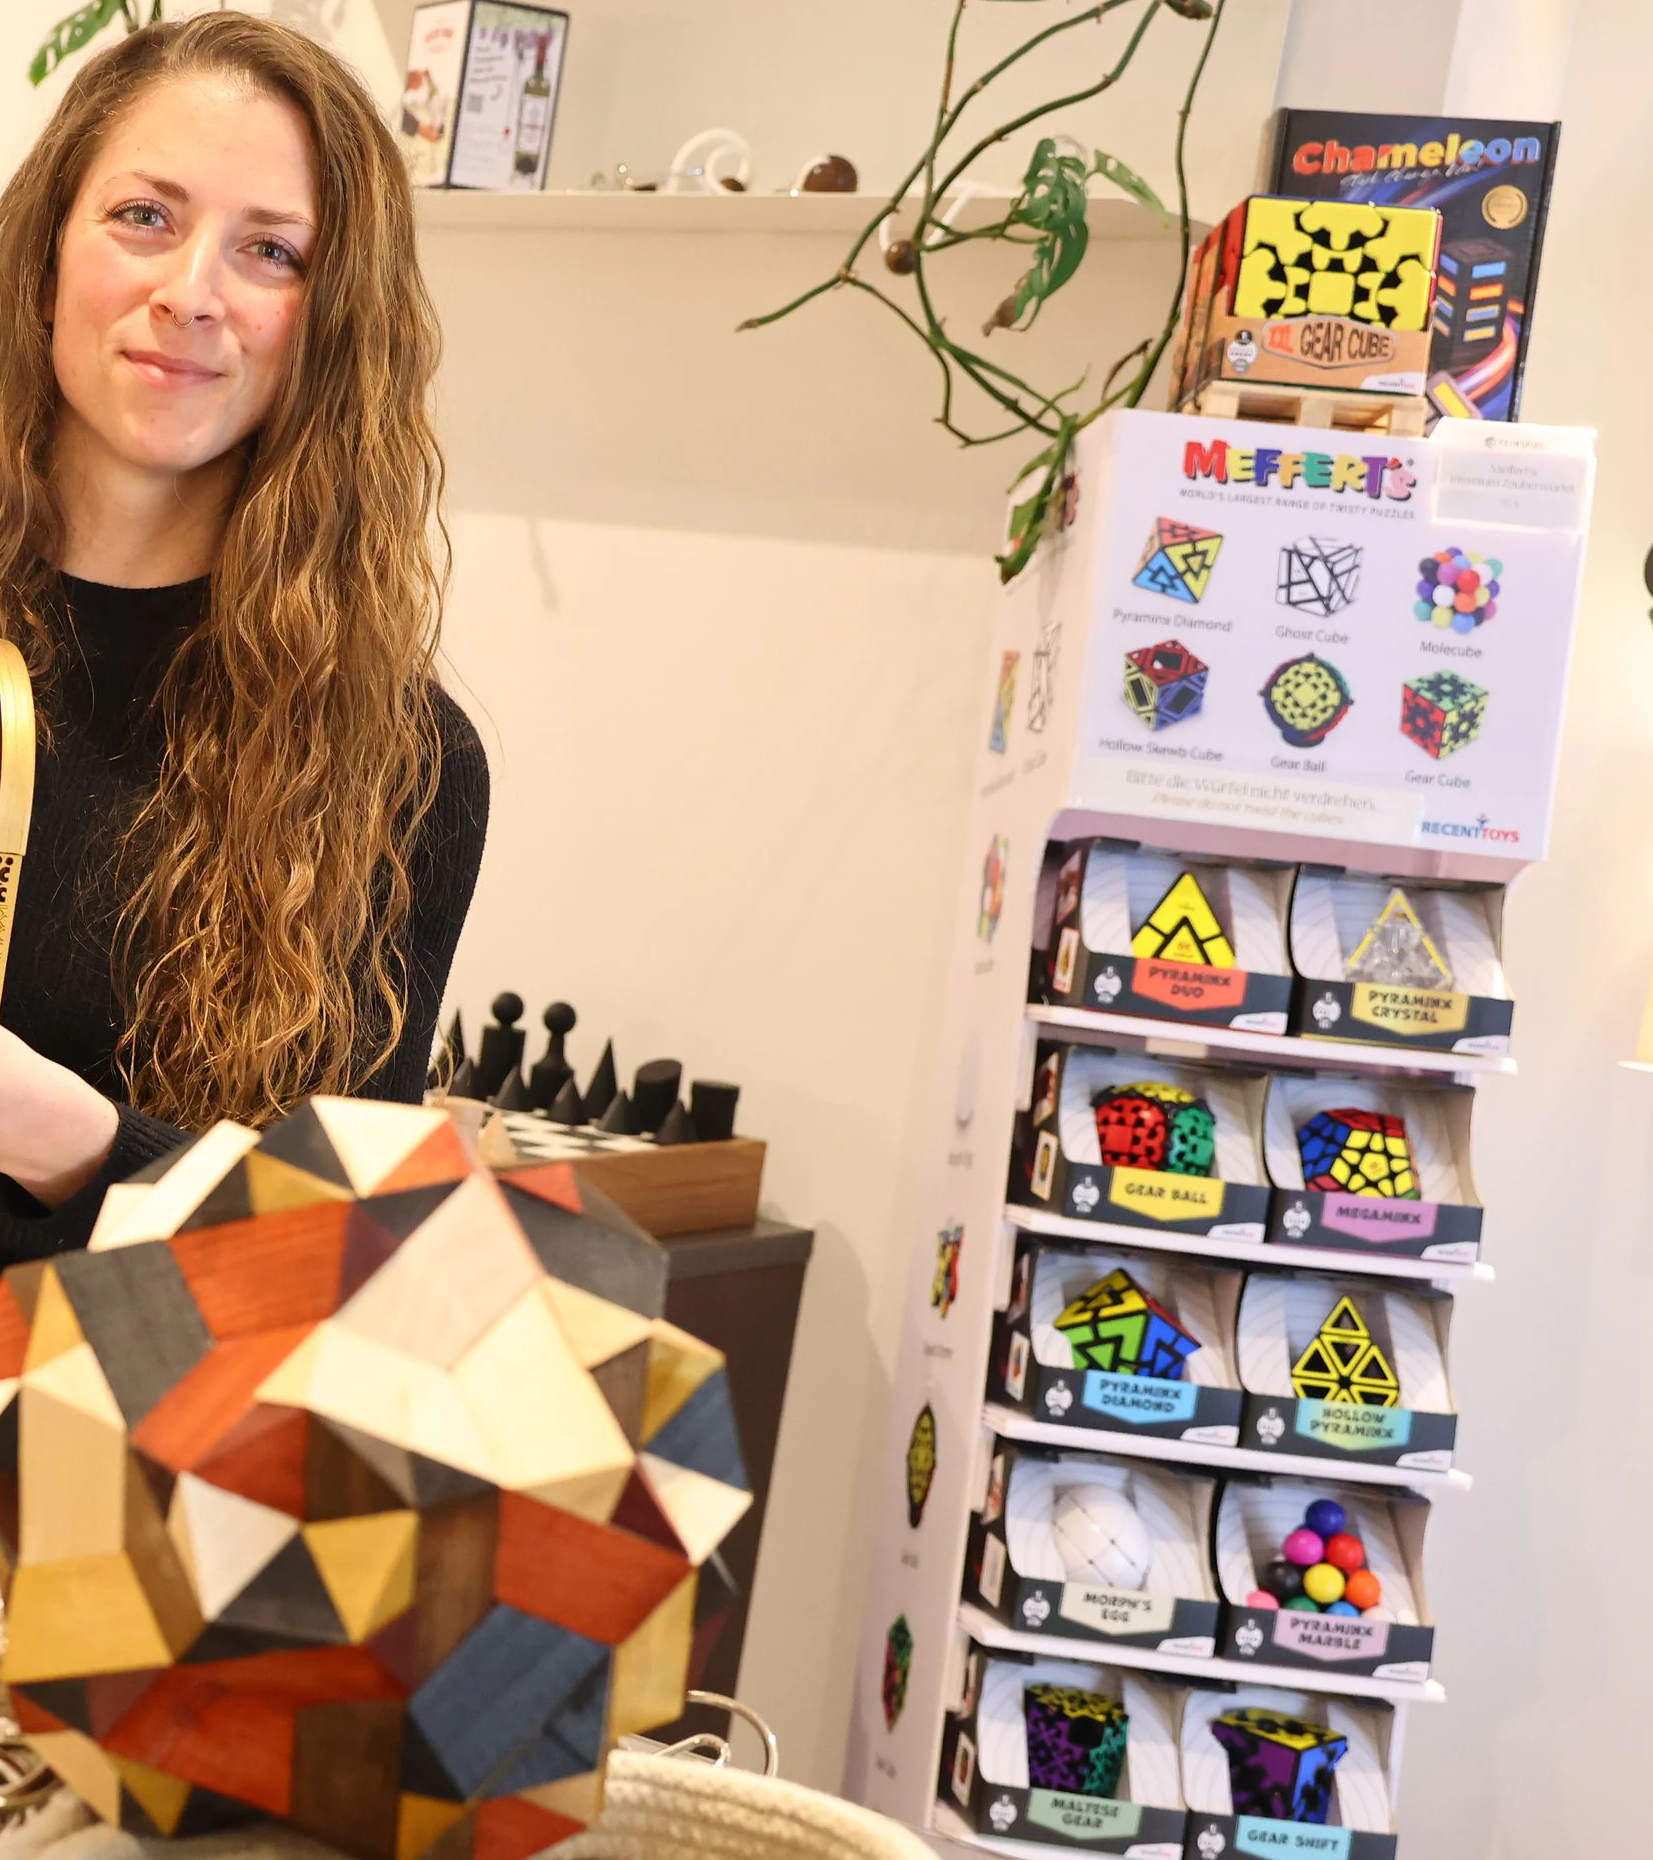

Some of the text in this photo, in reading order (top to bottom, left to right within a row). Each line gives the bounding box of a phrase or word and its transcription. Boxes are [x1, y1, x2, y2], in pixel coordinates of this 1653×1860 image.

[1292, 133, 1540, 175] Chameleon
[1268, 322, 1390, 362] XXL GEAR CUBE
[1183, 439, 1417, 500] MEFFERT'S
[1179, 488, 1415, 520] WORLD'S LARGEST RANGE OF TWISTY PUZZLES
[1112, 607, 1233, 633] Pyraminx Diamond
[1275, 624, 1350, 645] Ghost Cube
[1419, 640, 1483, 659] Molecube
[1099, 737, 1143, 752] Hollow
[1190, 748, 1224, 762] Cube
[1270, 755, 1327, 773] Gear Ball
[1404, 769, 1471, 789] Gear Cube
[1149, 966, 1232, 987] PYRAMINX
[1170, 984, 1204, 999] DUO
[1369, 990, 1453, 1010] PYRAMINX
[1372, 1006, 1439, 1024] CRYSTAL
[1125, 1182, 1208, 1204] GEAR BALL
[1336, 1206, 1423, 1225] MEGAMINX
[1100, 1378, 1183, 1399] PYRAMINX
[1101, 1394, 1176, 1414] DIAMOND
[1323, 1407, 1387, 1424] HOLLOW
[1310, 1420, 1395, 1440] PYRAMINX
[1100, 1609, 1130, 1624] EGG
[1290, 1617, 1374, 1637] PYRAMINX
[1298, 1633, 1362, 1650] MARBLE
[1051, 1798, 1119, 1818] MALTESE
[1062, 1813, 1104, 1829] GEAR
[1247, 1829, 1339, 1851] GEAR SHIFT
